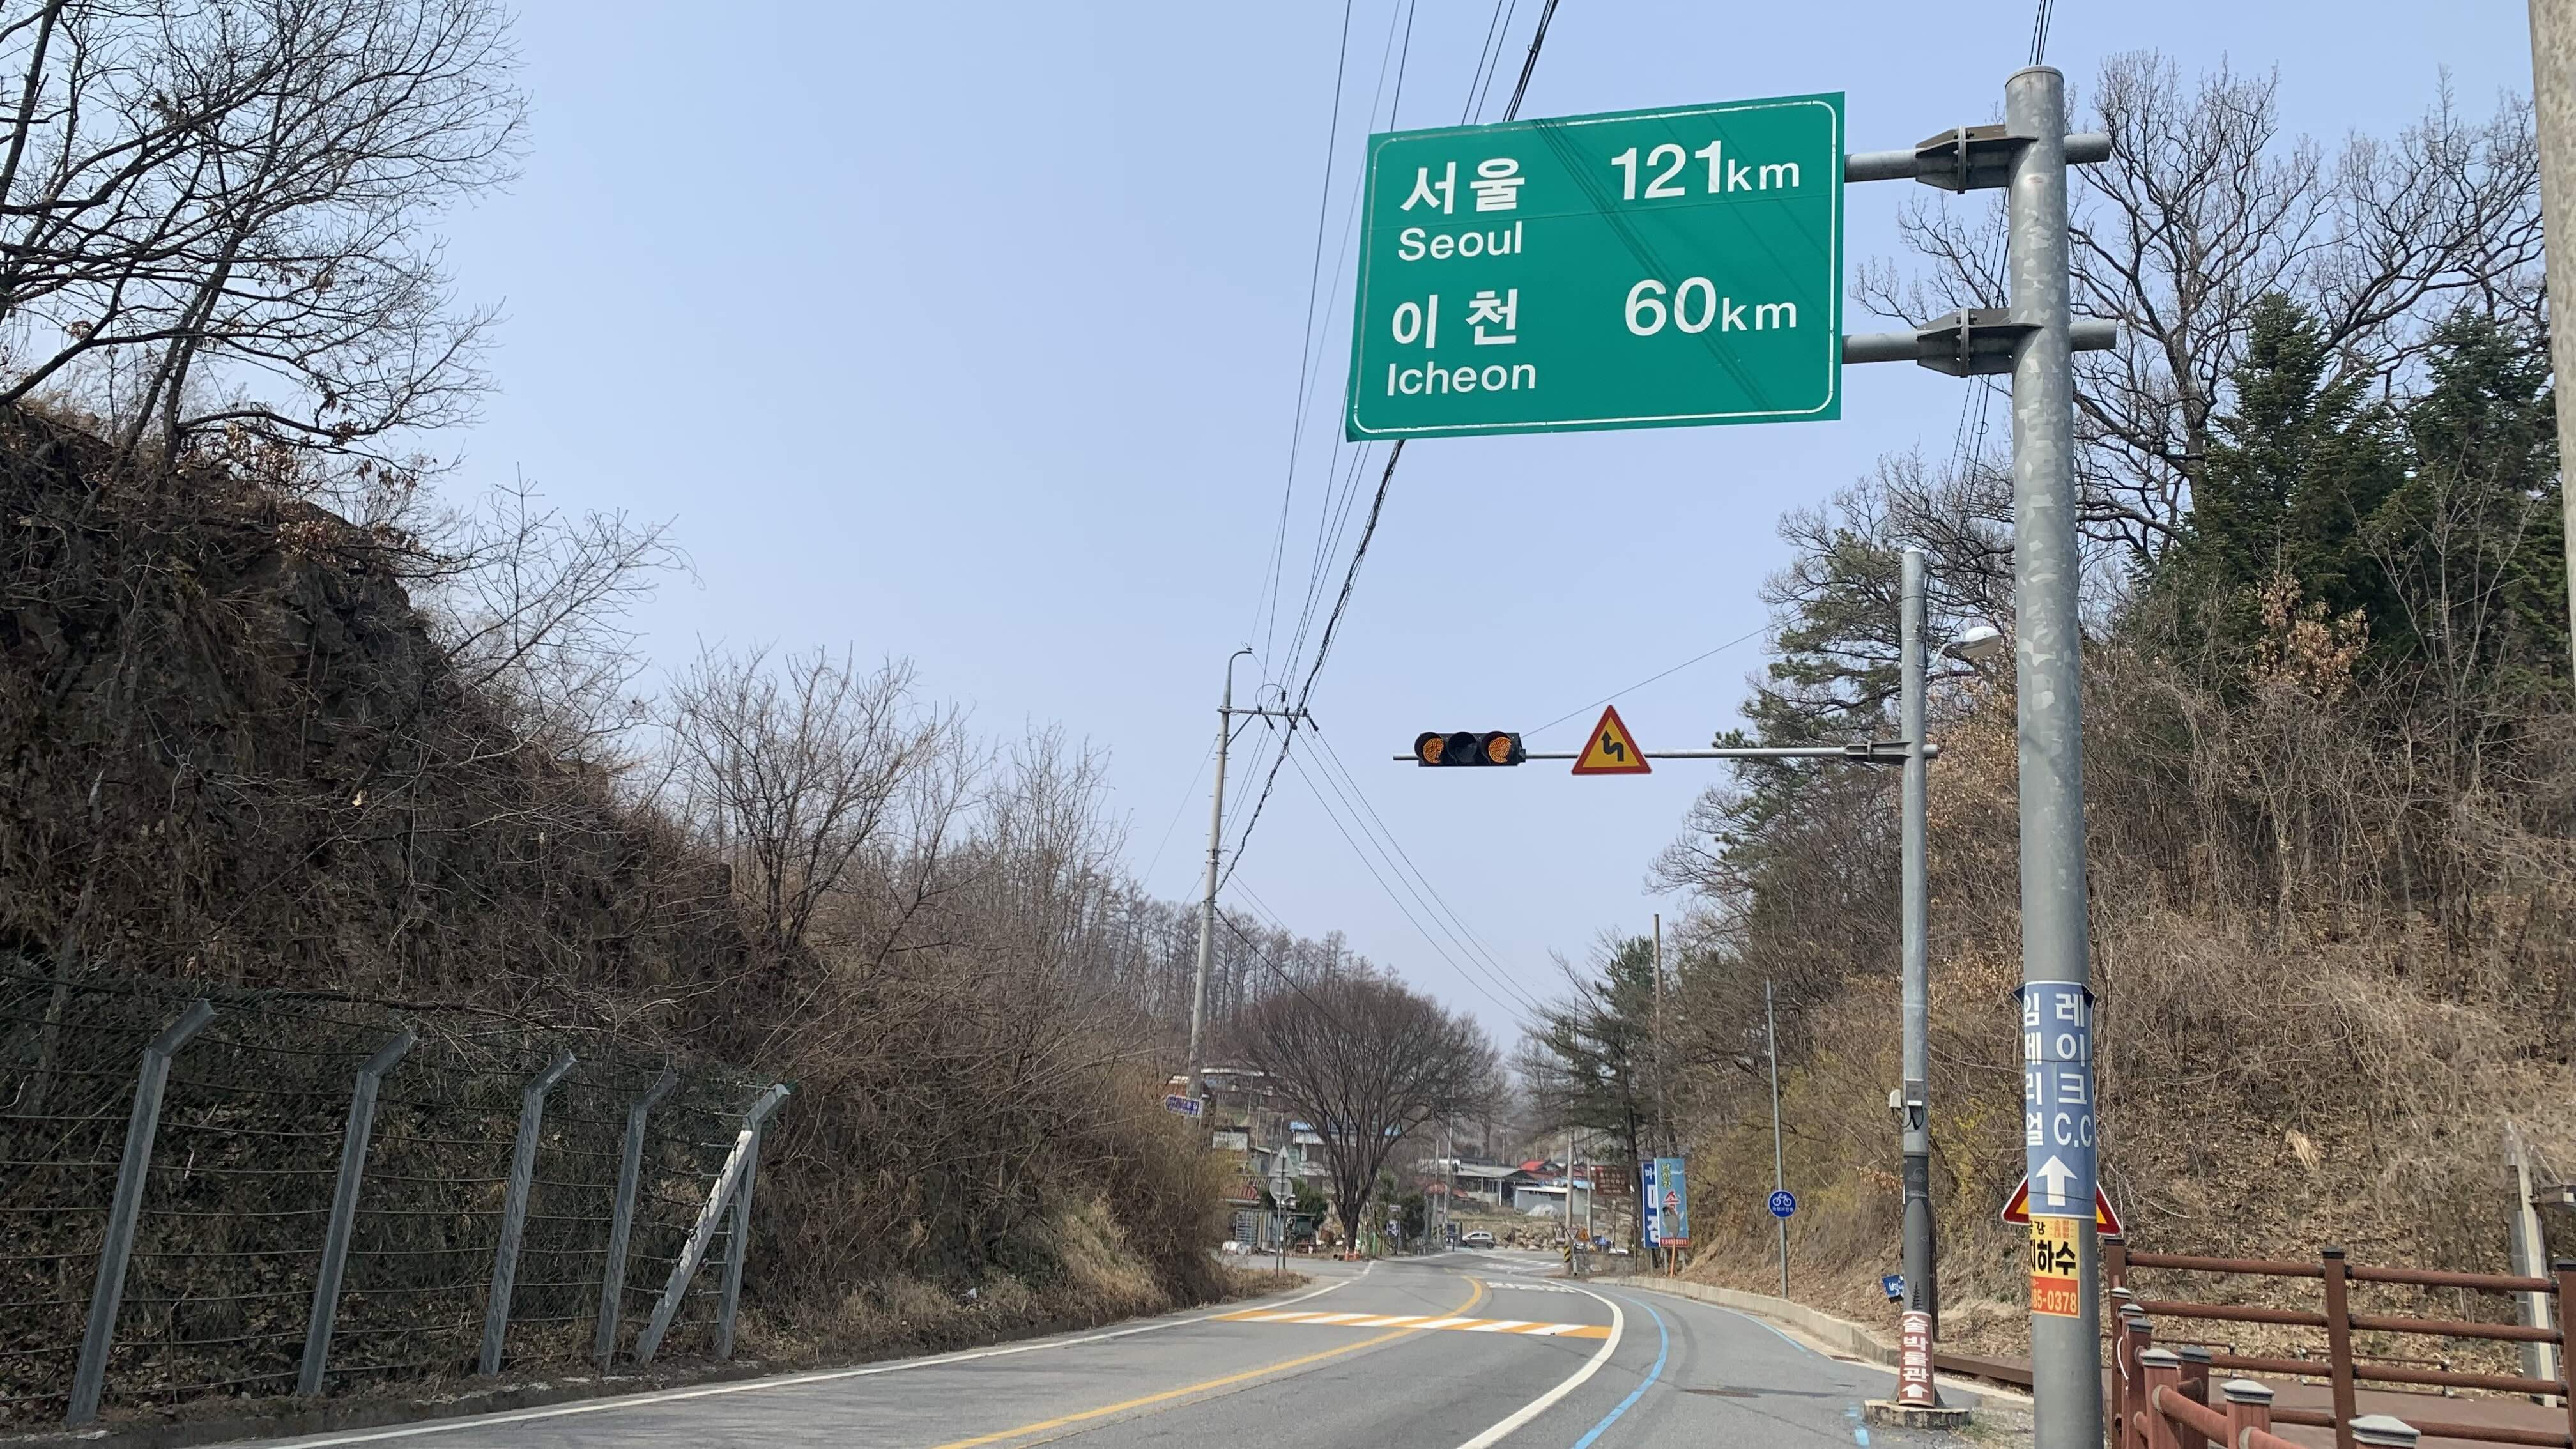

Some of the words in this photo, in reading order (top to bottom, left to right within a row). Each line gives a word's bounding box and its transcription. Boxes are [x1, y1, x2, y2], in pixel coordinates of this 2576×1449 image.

[1400, 158, 1525, 215] 서울
[1611, 140, 1800, 201] 121km
[1398, 221, 1522, 261] Seoul
[1392, 289, 1517, 349] 이천
[1625, 276, 1797, 336] 60km
[1386, 361, 1536, 396] Icheon
